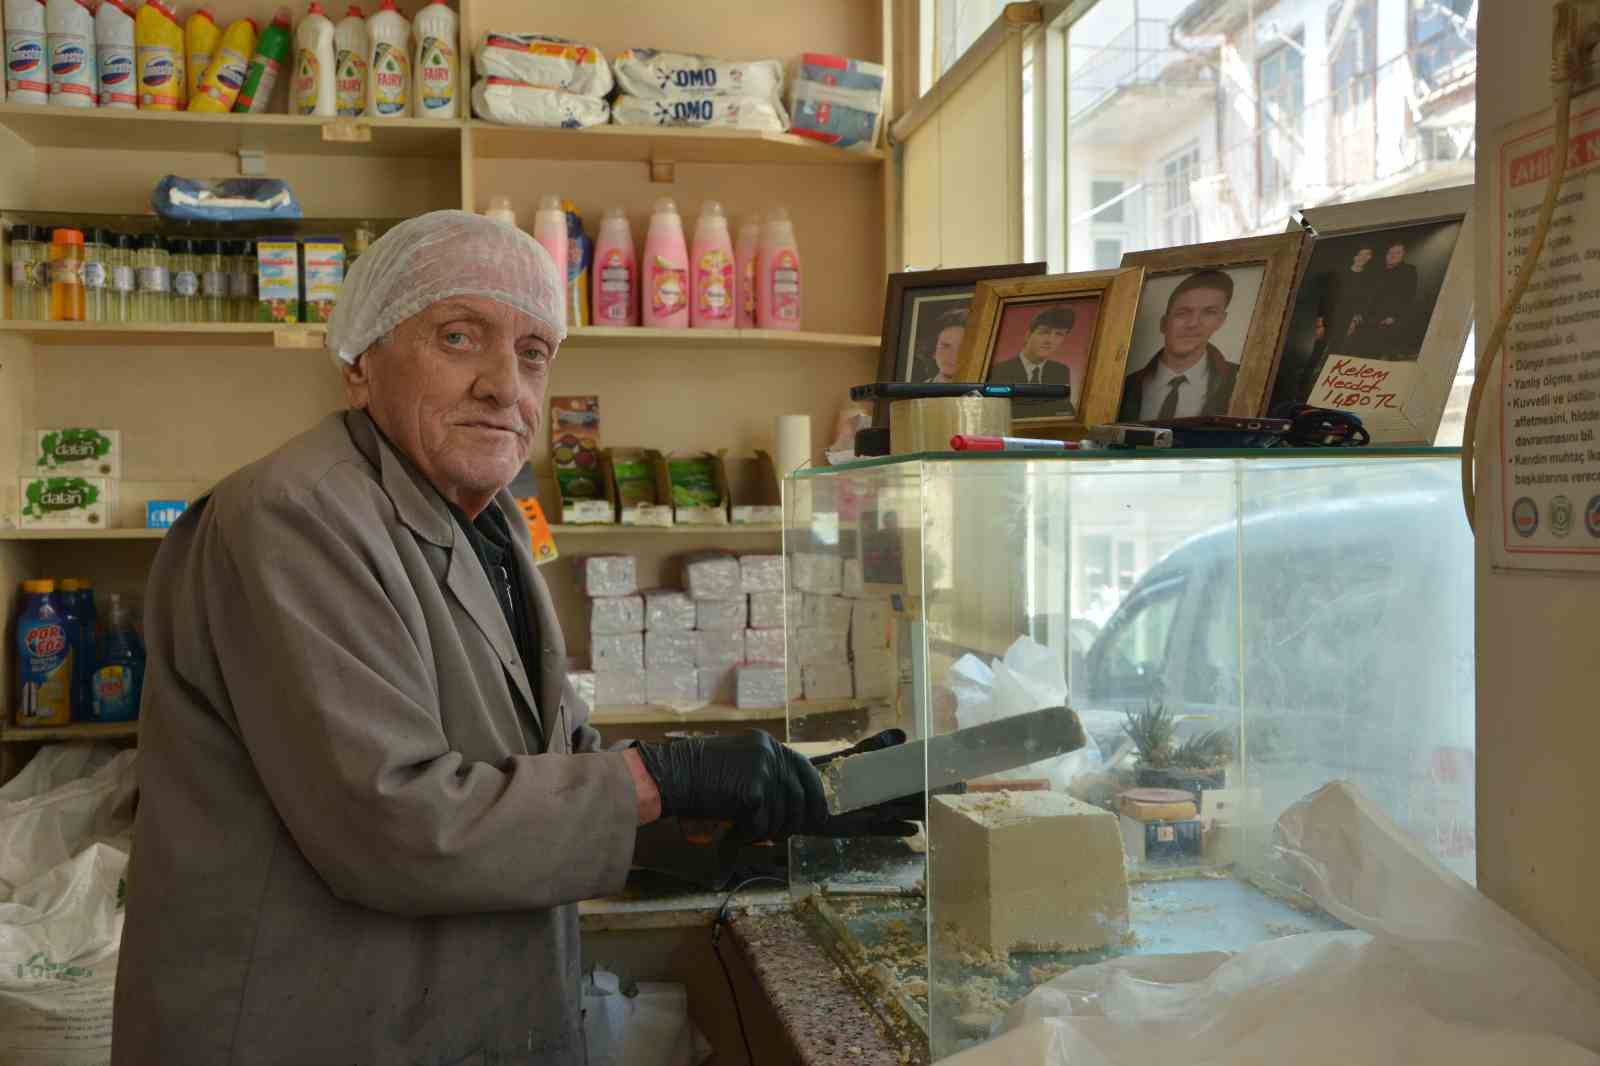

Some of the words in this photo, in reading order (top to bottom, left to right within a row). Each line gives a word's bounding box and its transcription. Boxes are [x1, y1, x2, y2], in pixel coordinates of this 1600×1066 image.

[377, 73, 401, 87] FAIRY
[423, 68, 449, 81] FAIRY
[675, 67, 717, 87] OMO
[55, 440, 96, 456] dalan
[41, 489, 82, 505] dalan
